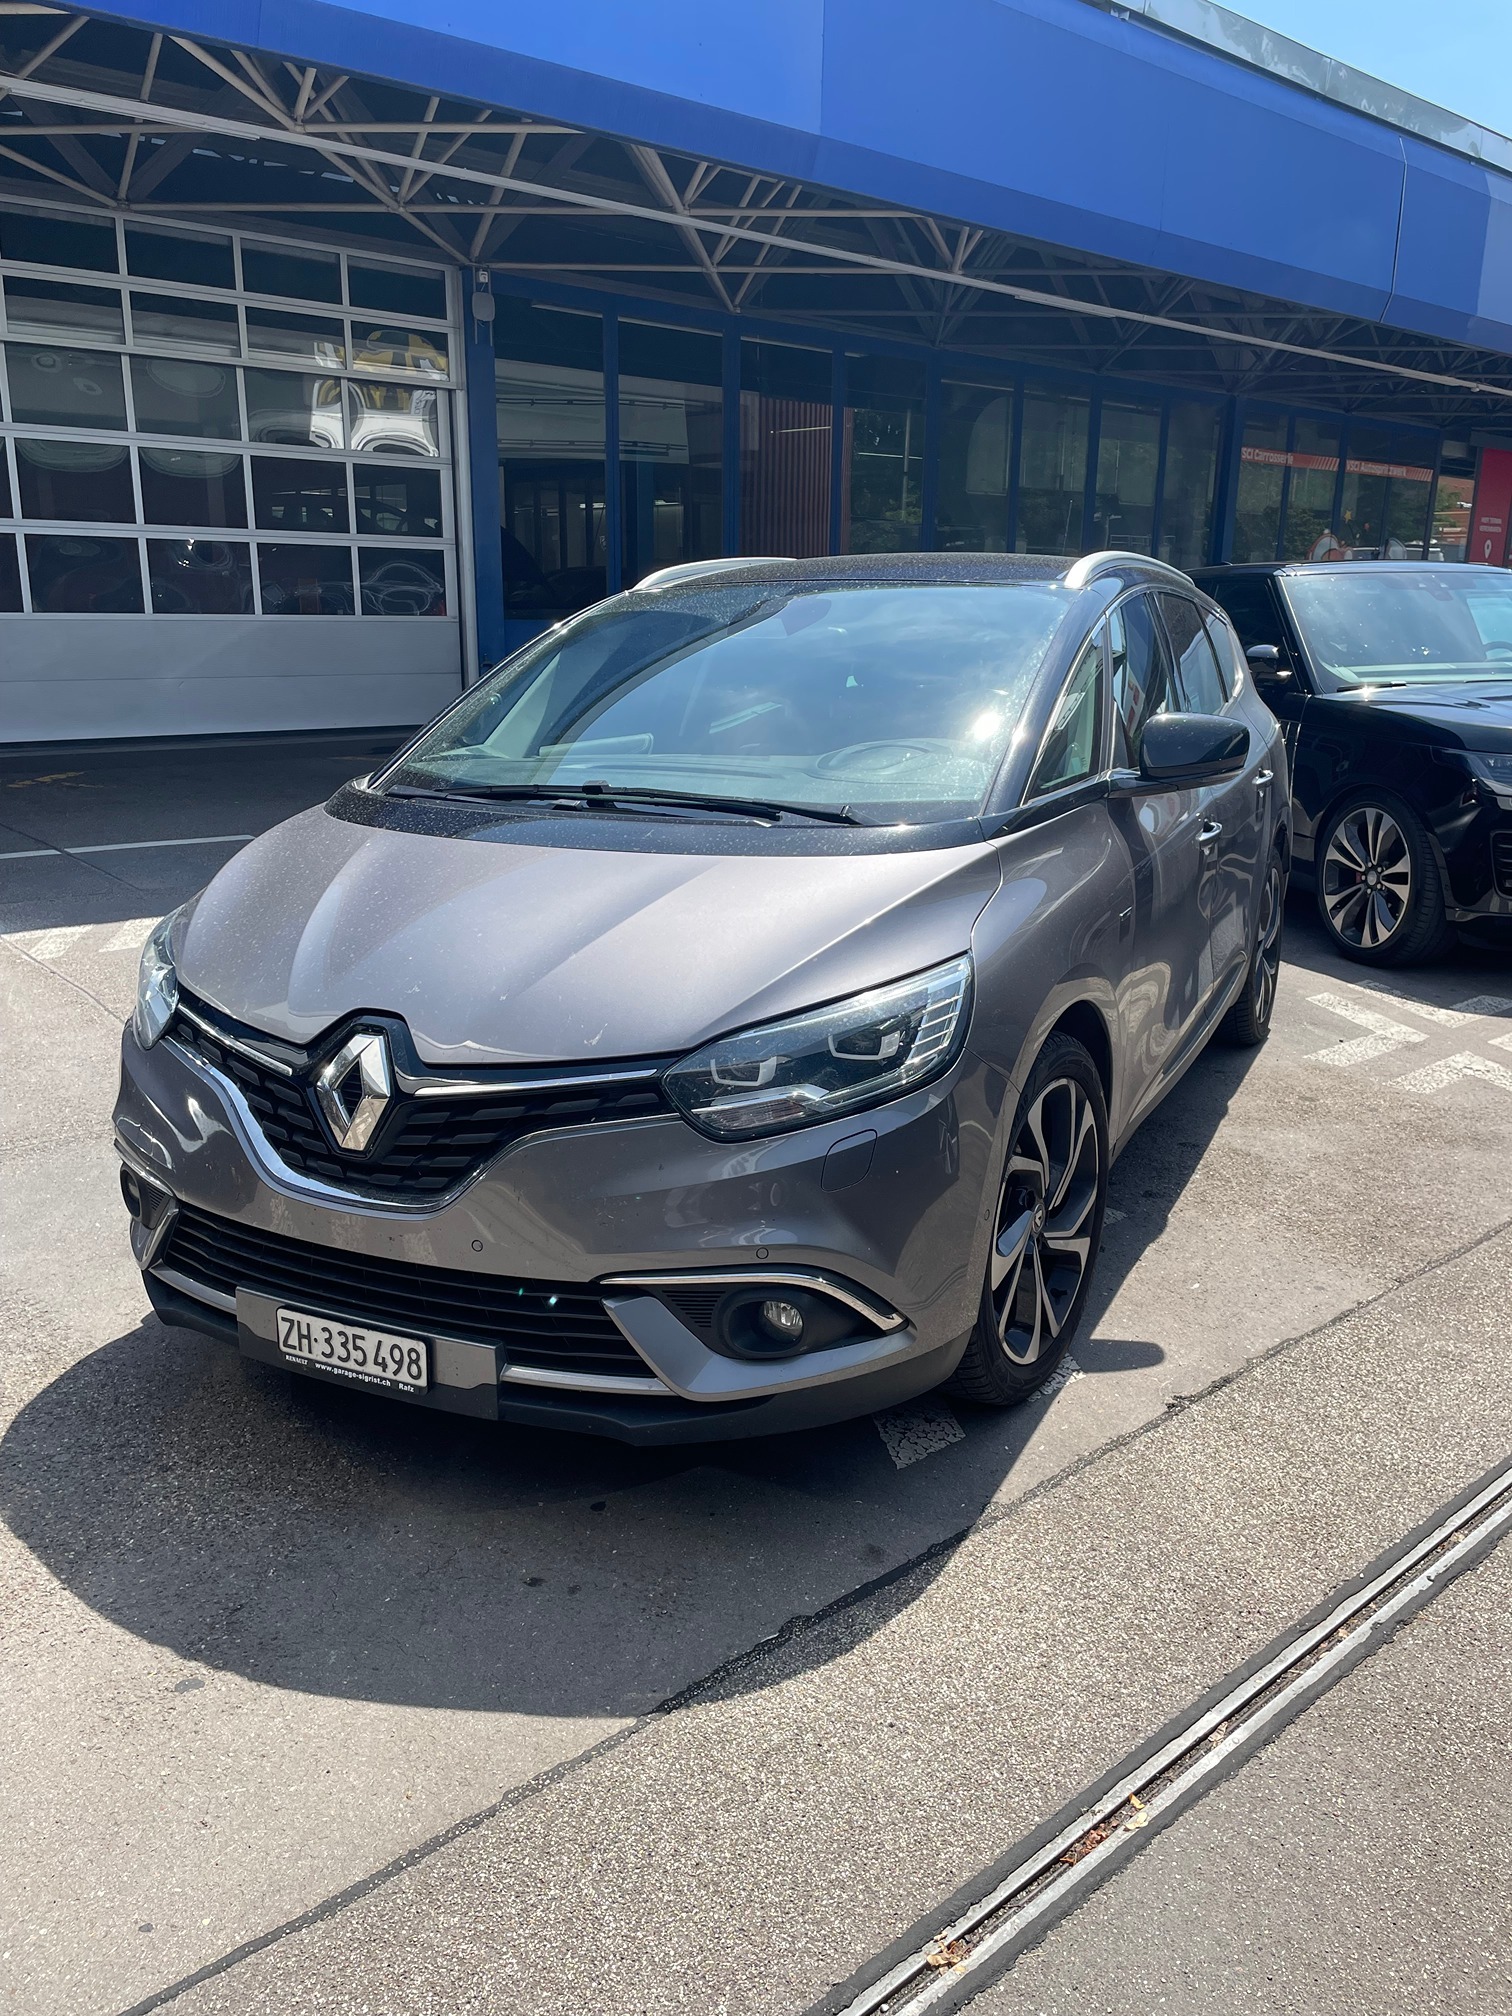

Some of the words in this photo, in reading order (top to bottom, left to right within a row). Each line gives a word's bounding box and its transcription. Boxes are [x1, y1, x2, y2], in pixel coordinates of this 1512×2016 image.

[285, 1354, 309, 1366] RENAULT
[314, 1362, 391, 1387] www.garage-sigrist.ch
[398, 1382, 415, 1393] Rafz
